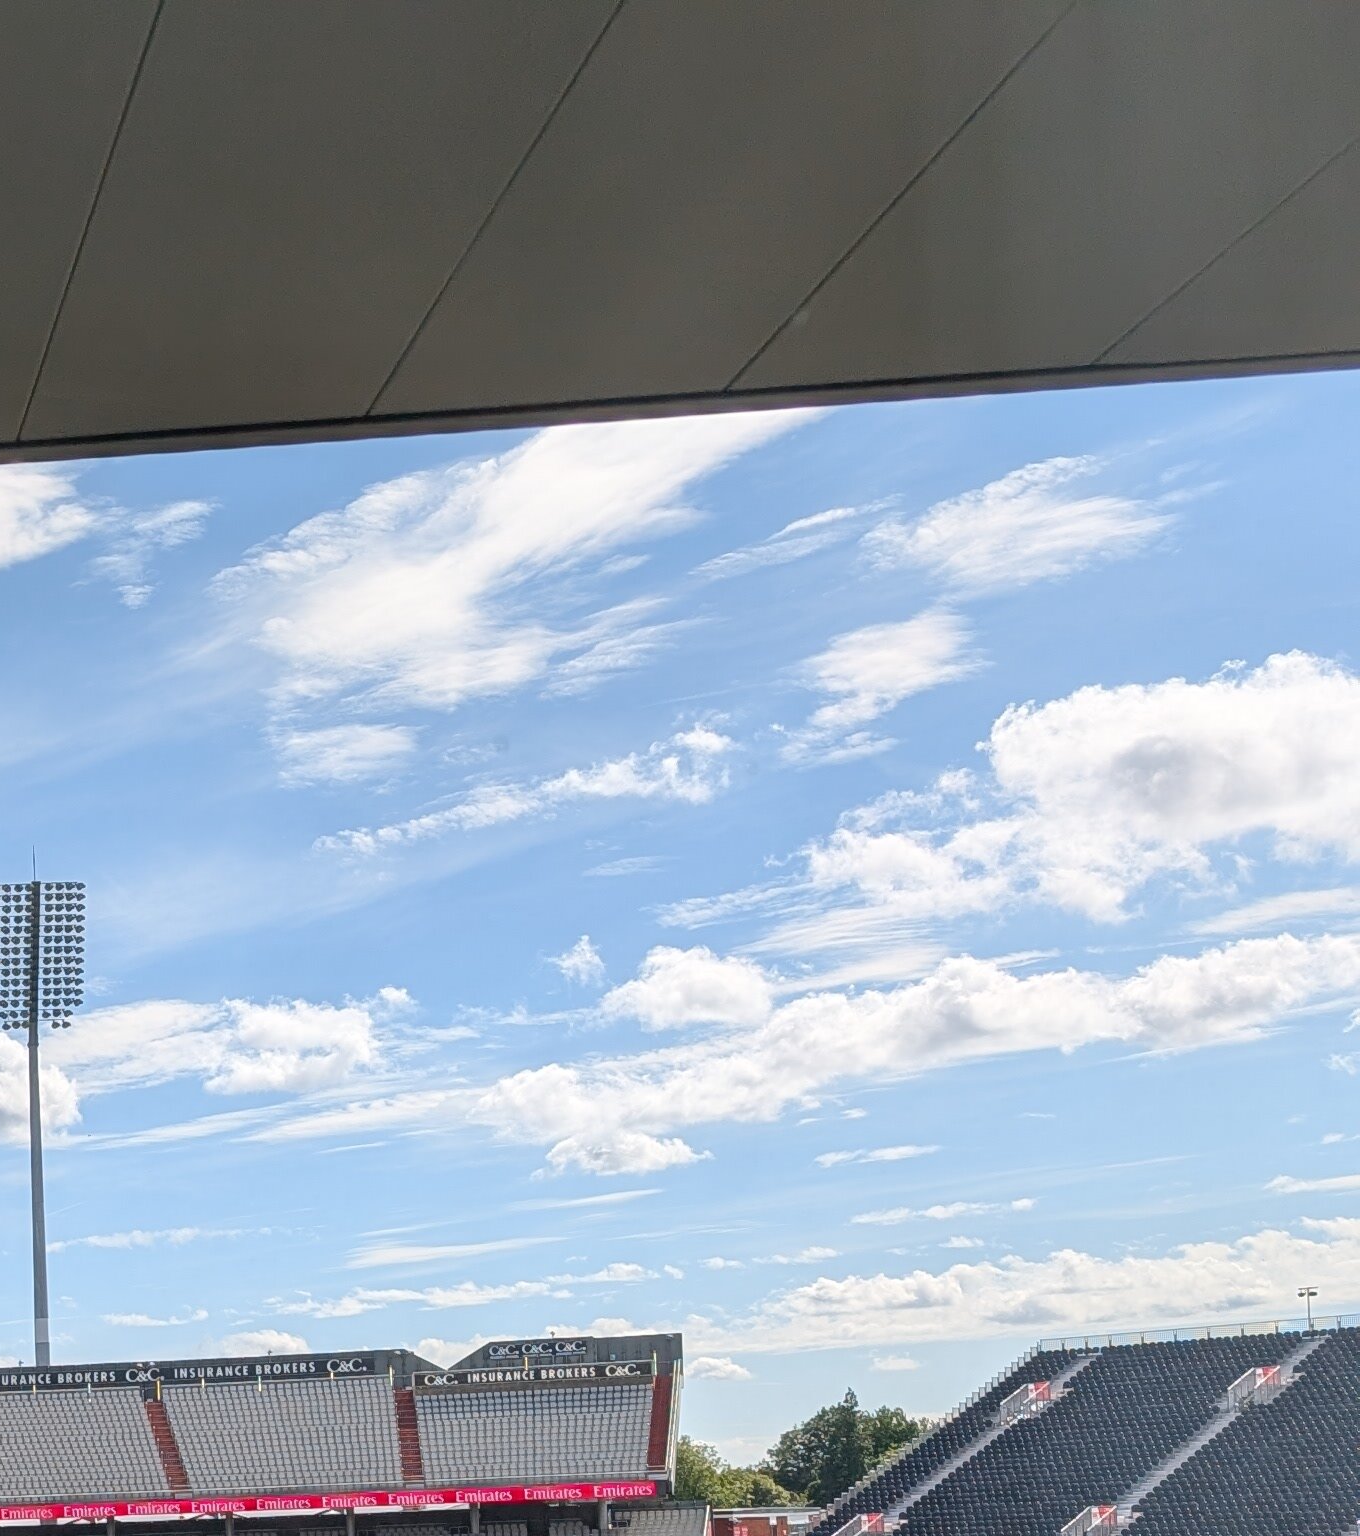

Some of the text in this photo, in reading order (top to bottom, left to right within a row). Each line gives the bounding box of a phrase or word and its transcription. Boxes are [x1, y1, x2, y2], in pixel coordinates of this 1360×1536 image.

[174, 1365, 249, 1379] INSURANCE
[255, 1362, 316, 1375] BROKERS
[467, 1370, 535, 1383] INSURANCE
[541, 1367, 596, 1380] BROKERS
[58, 1371, 116, 1385] BROKERS
[455, 1490, 513, 1503] Emirates
[524, 1487, 582, 1500] Emirates
[593, 1484, 653, 1498] Emirates
[256, 1498, 311, 1511] Emirates
[322, 1495, 377, 1508] Emirates
[388, 1493, 445, 1505] Emirates
[63, 1504, 117, 1518] Emirates
[127, 1502, 181, 1515] Emirates
[191, 1500, 245, 1513] Emirates
[0, 1507, 53, 1520] Emirates
